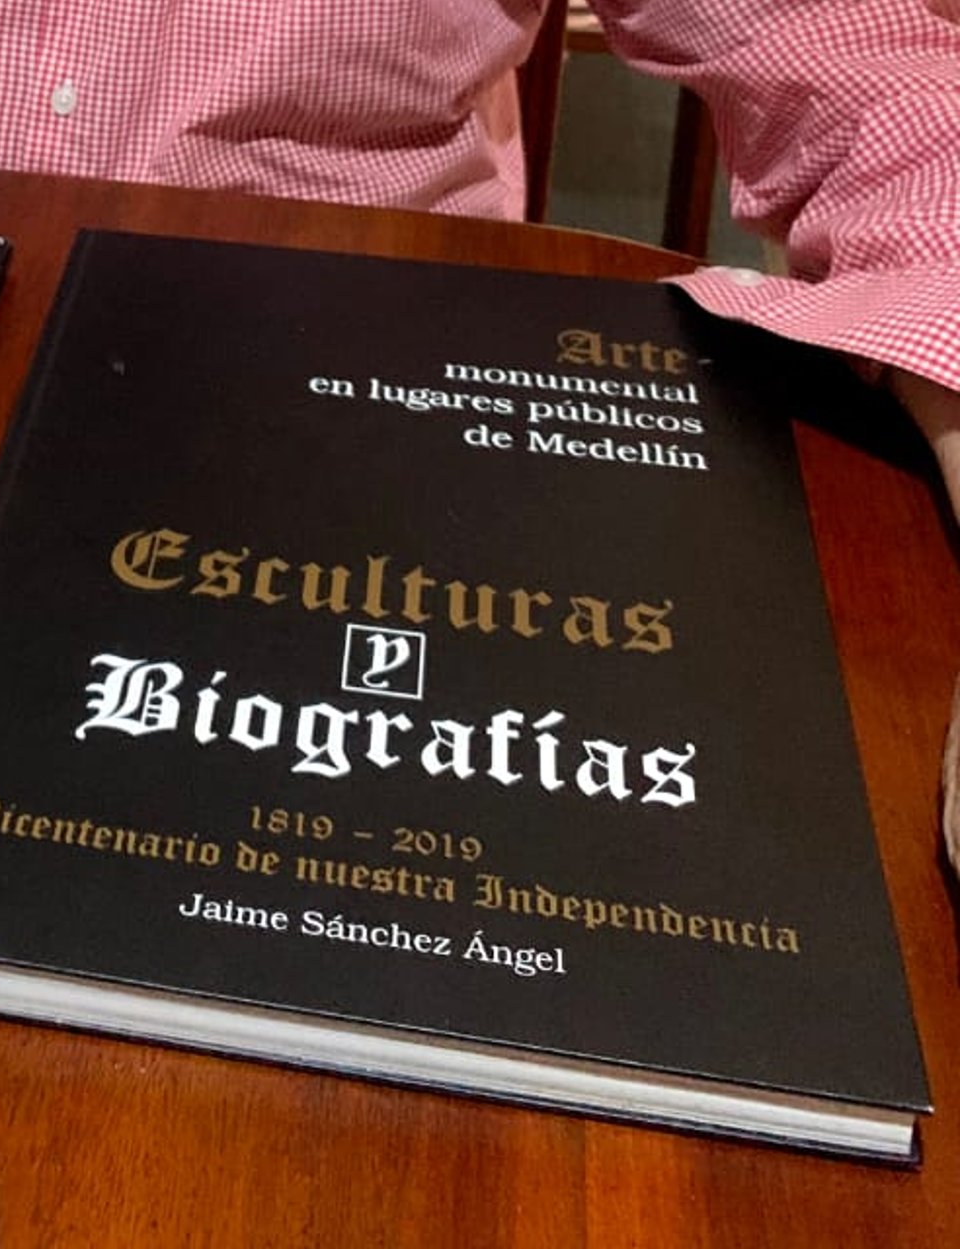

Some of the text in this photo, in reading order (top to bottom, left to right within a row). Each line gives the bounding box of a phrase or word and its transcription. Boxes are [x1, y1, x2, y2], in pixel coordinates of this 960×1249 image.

[556, 329, 688, 374] Arte
[308, 376, 705, 434] en lugares públicos
[443, 362, 700, 404] monumental
[463, 424, 709, 471] de Medellín
[110, 528, 675, 653] Esculturas
[75, 652, 696, 808] Biografías
[249, 805, 334, 841] 1819
[391, 826, 483, 862] 2019
[236, 840, 281, 876] de
[295, 854, 456, 904] nuestra
[473, 873, 801, 953] Independencia
[178, 893, 566, 977] Jaime Sánchez Ángel
